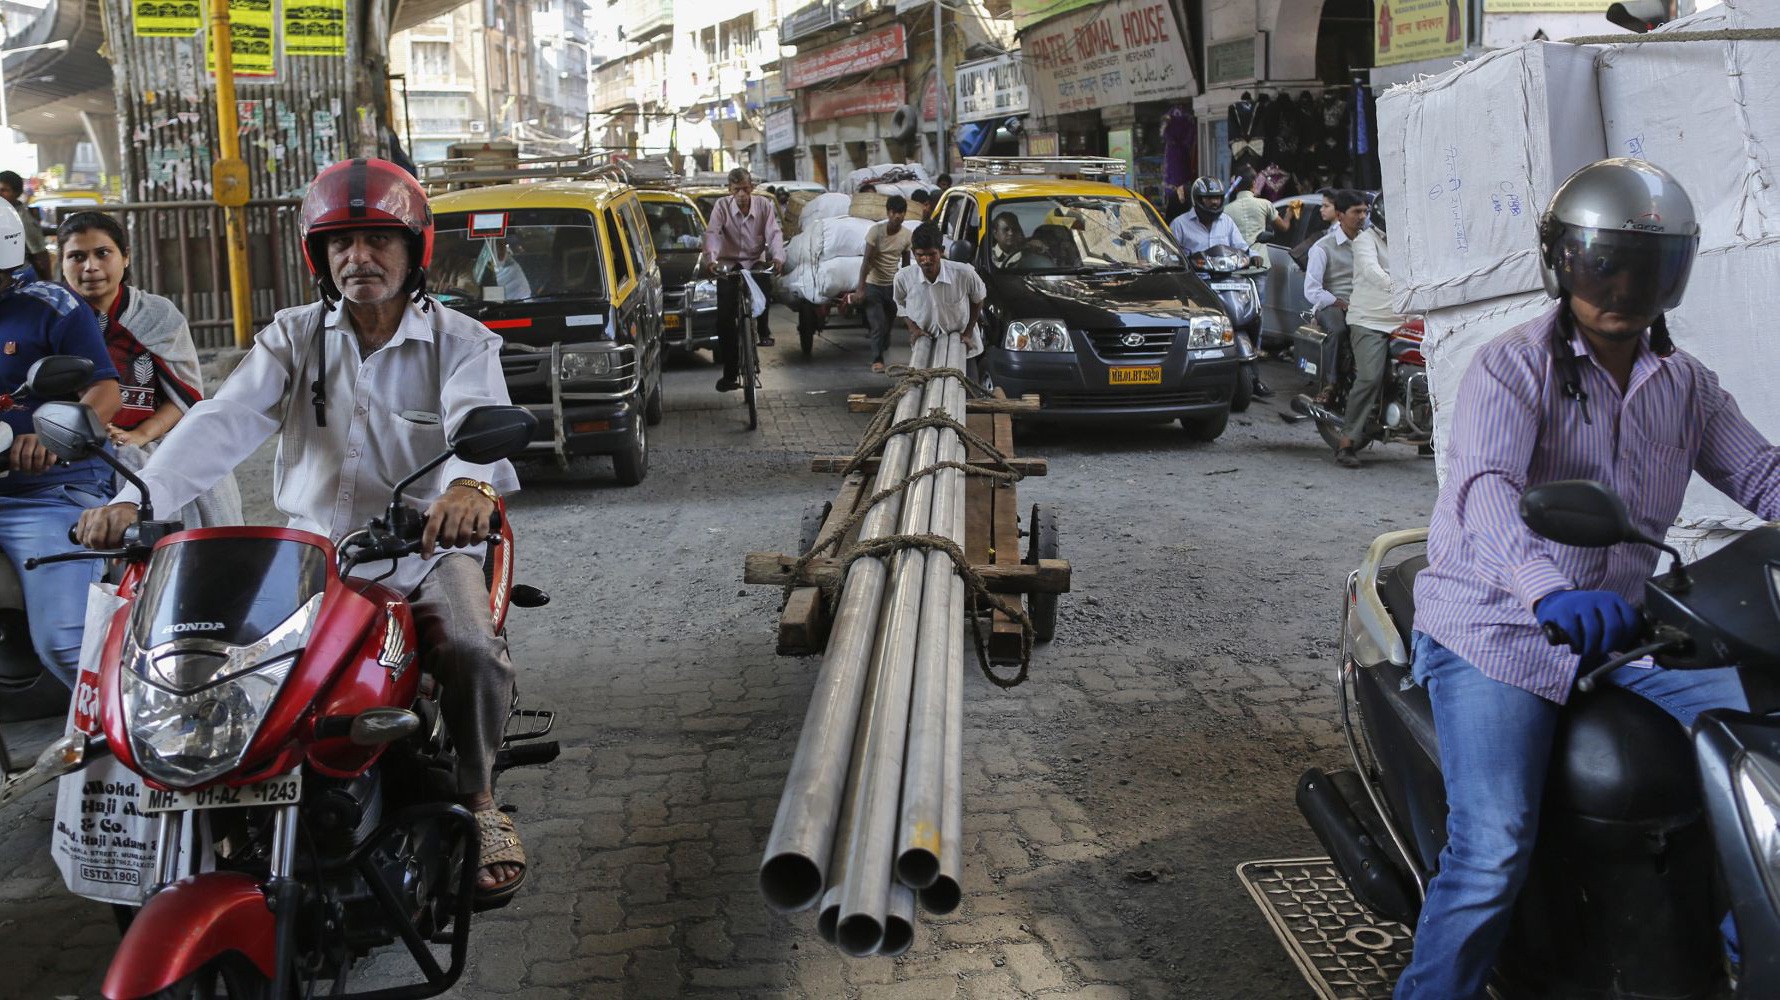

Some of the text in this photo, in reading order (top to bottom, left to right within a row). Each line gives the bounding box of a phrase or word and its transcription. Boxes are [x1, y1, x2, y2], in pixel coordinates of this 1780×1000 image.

[1032, 32, 1074, 71] PATEL
[1120, 4, 1170, 49] HOUSE
[161, 622, 226, 635] HONDA
[82, 781, 140, 797] Mohd.
[81, 798, 117, 817] Haji
[81, 818, 127, 834] & Co.
[80, 835, 106, 848] Haji
[111, 836, 147, 851] Adam
[83, 868, 138, 882] ESTD.1905
